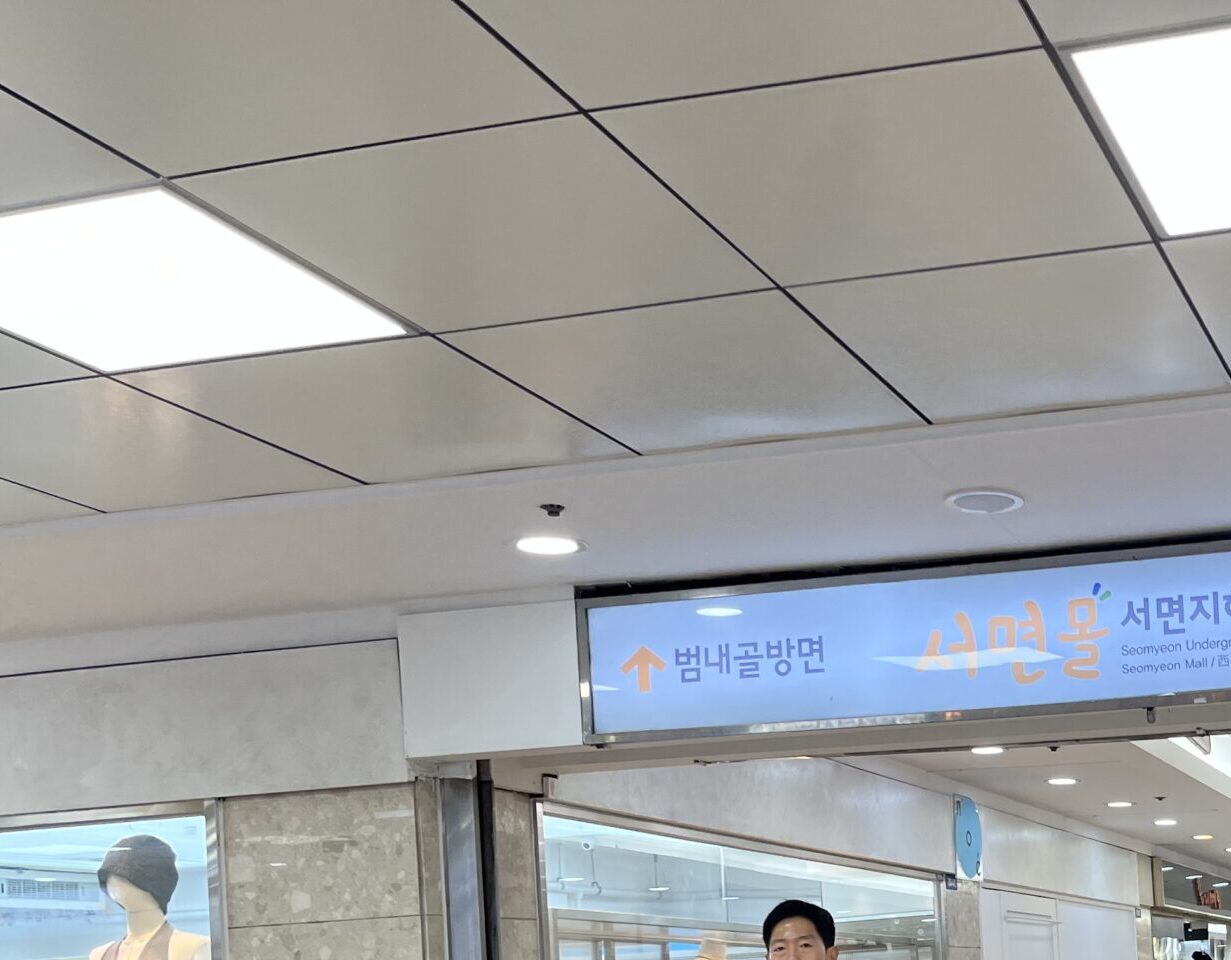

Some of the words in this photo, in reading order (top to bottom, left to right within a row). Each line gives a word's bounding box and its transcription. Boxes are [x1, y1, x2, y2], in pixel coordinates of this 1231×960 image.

[915, 597, 1110, 685] 서면몰
[1120, 642, 1182, 658] Seomyeon
[674, 635, 825, 684] 범내골방면
[1120, 660, 1181, 675] Seomyeon
[1185, 656, 1209, 669] Mall
